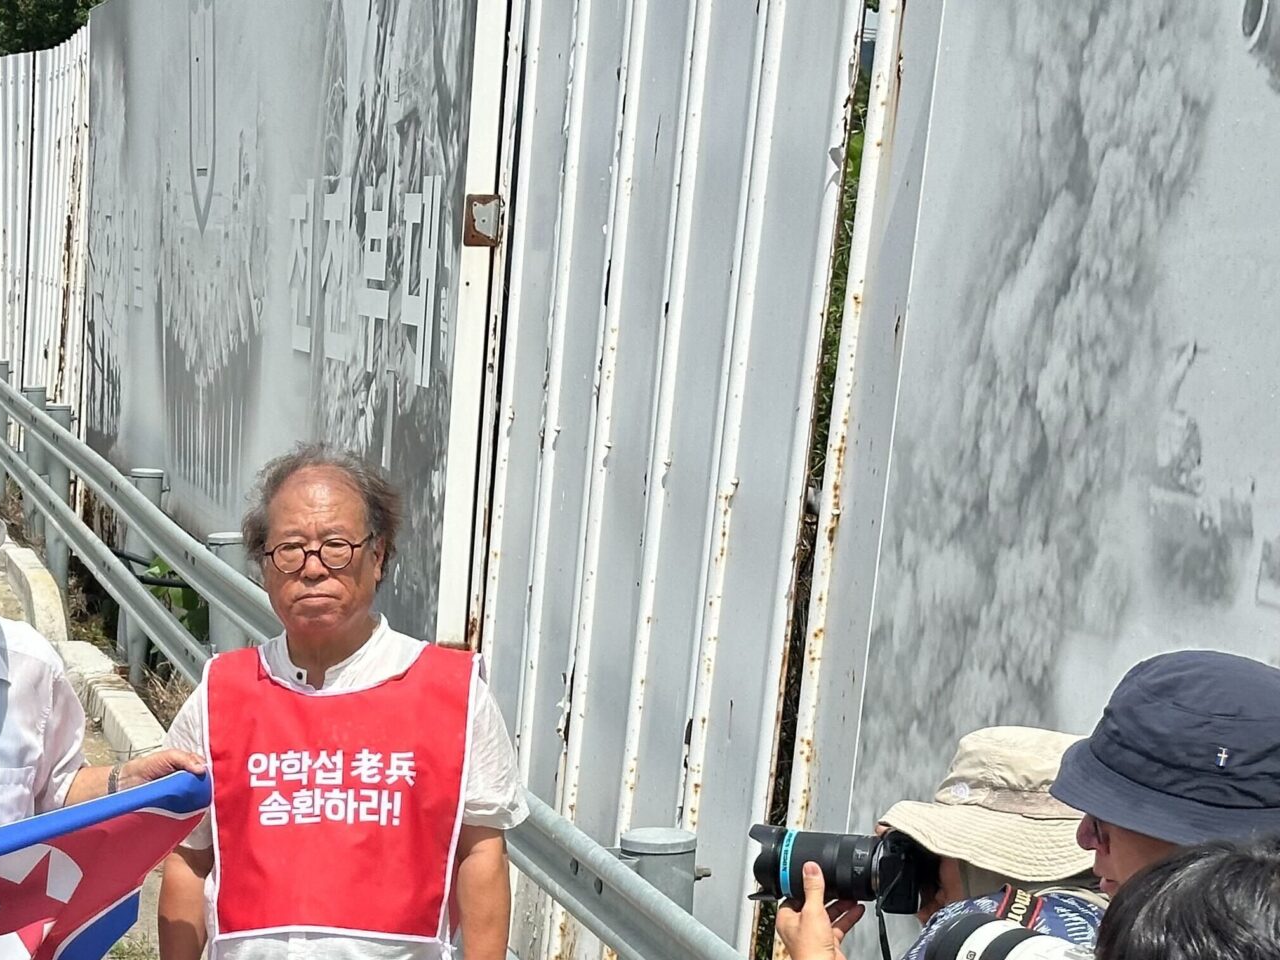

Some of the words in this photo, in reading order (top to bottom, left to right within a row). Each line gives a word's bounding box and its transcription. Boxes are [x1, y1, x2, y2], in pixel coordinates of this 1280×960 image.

[247, 749, 344, 787] 안학섭
[350, 748, 418, 787] 老兵
[258, 788, 402, 826] 송환하라!
